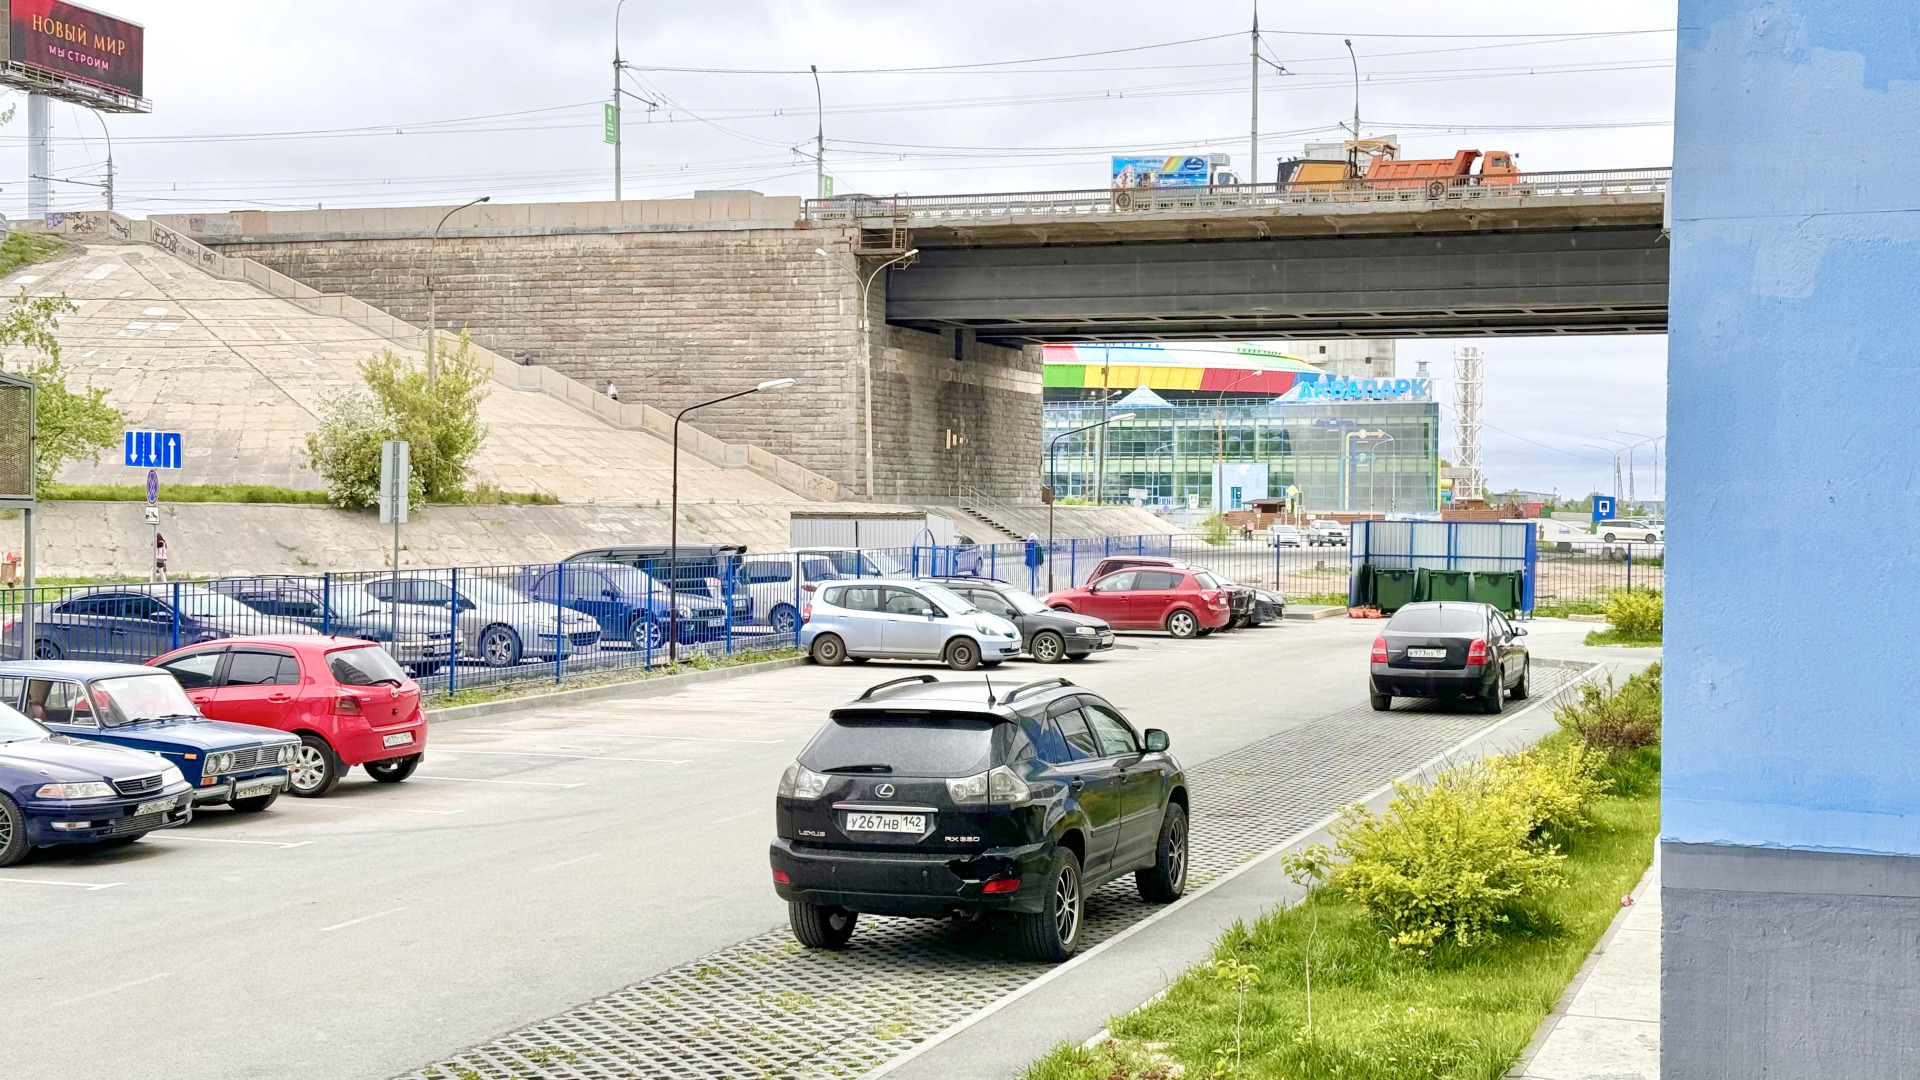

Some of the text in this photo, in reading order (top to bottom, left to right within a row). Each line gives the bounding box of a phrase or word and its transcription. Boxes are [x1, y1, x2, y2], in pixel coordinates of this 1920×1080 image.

[32, 13, 126, 56] НОВЫЙ МИР
[49, 45, 65, 58] МЫ
[67, 50, 109, 71] СТРОИМ
[1299, 379, 1428, 399] АКВАПАРК
[851, 815, 922, 830] У267НВ 142
[798, 829, 826, 837] LEXUS
